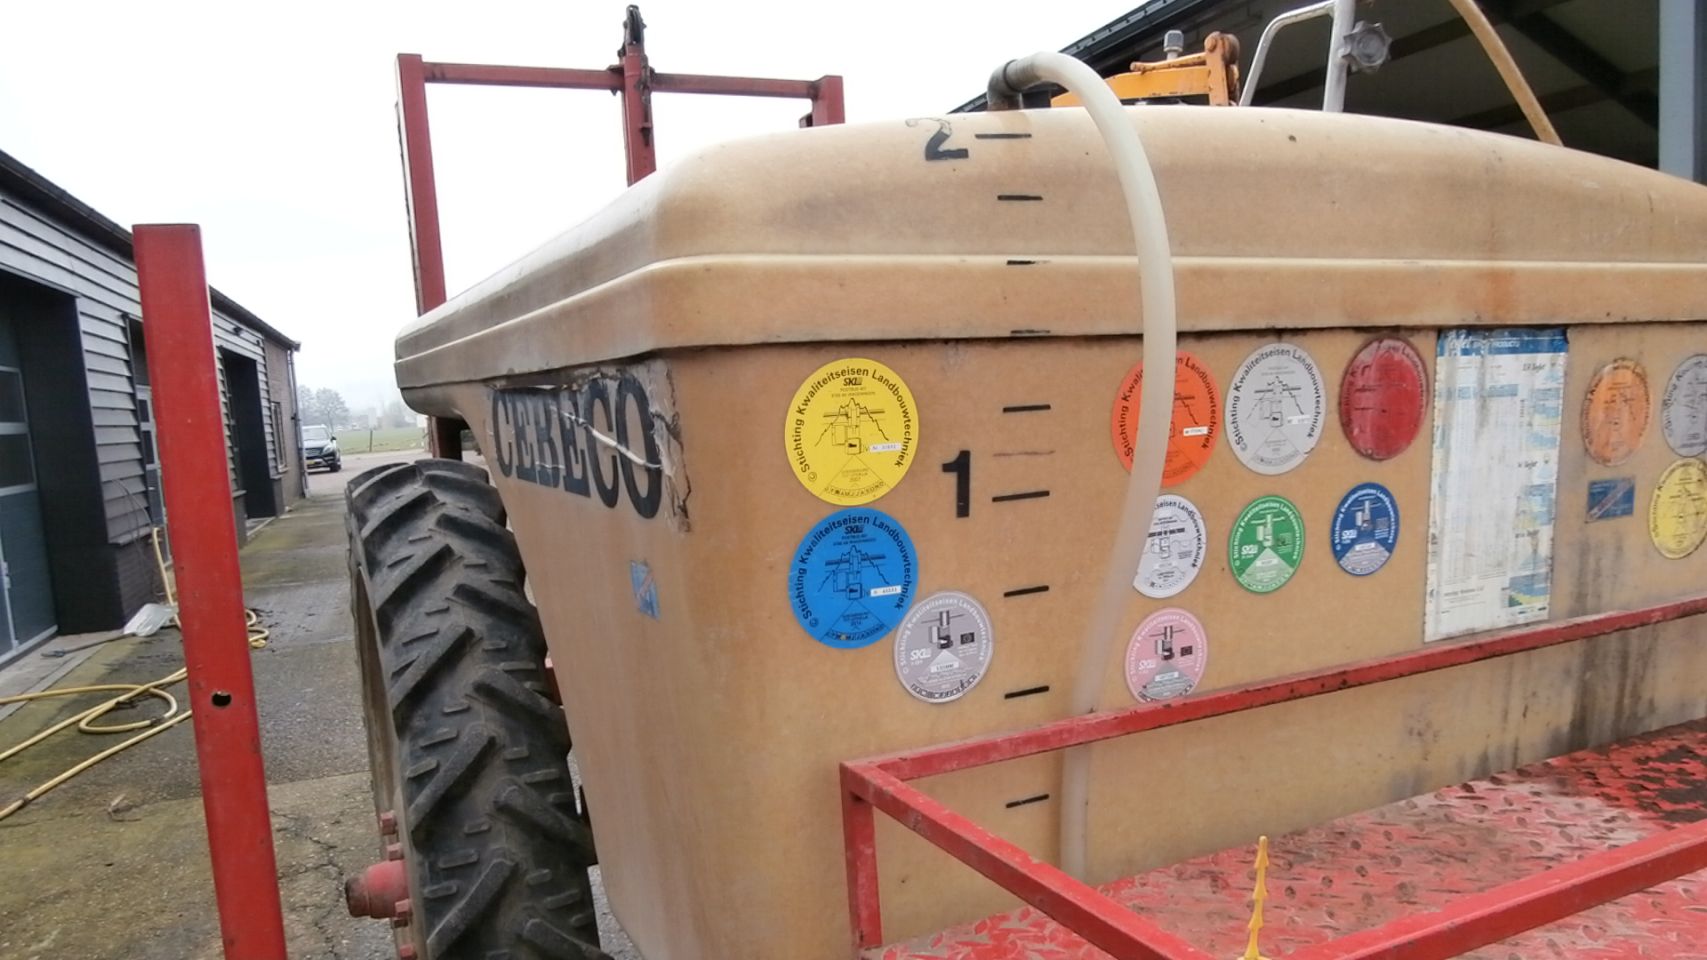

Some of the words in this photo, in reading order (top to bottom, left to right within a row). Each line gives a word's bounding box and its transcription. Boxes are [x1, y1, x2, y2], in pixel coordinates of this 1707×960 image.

[796, 365, 870, 416] Kwaliteitseisen
[872, 368, 912, 468] Landbouwtechniek
[1117, 405, 1134, 457] Stichting
[1185, 356, 1217, 450] Landbouwtechniek
[1229, 395, 1245, 446] Stichting
[1291, 348, 1322, 438] Landbouwtechniek
[492, 372, 662, 519] CEBECO
[791, 417, 810, 474] Stichting
[941, 450, 971, 518] 1
[799, 514, 870, 565] Kwaliteitseisen
[872, 515, 913, 610] Landbouwtechniek
[795, 566, 813, 620] Stichting
